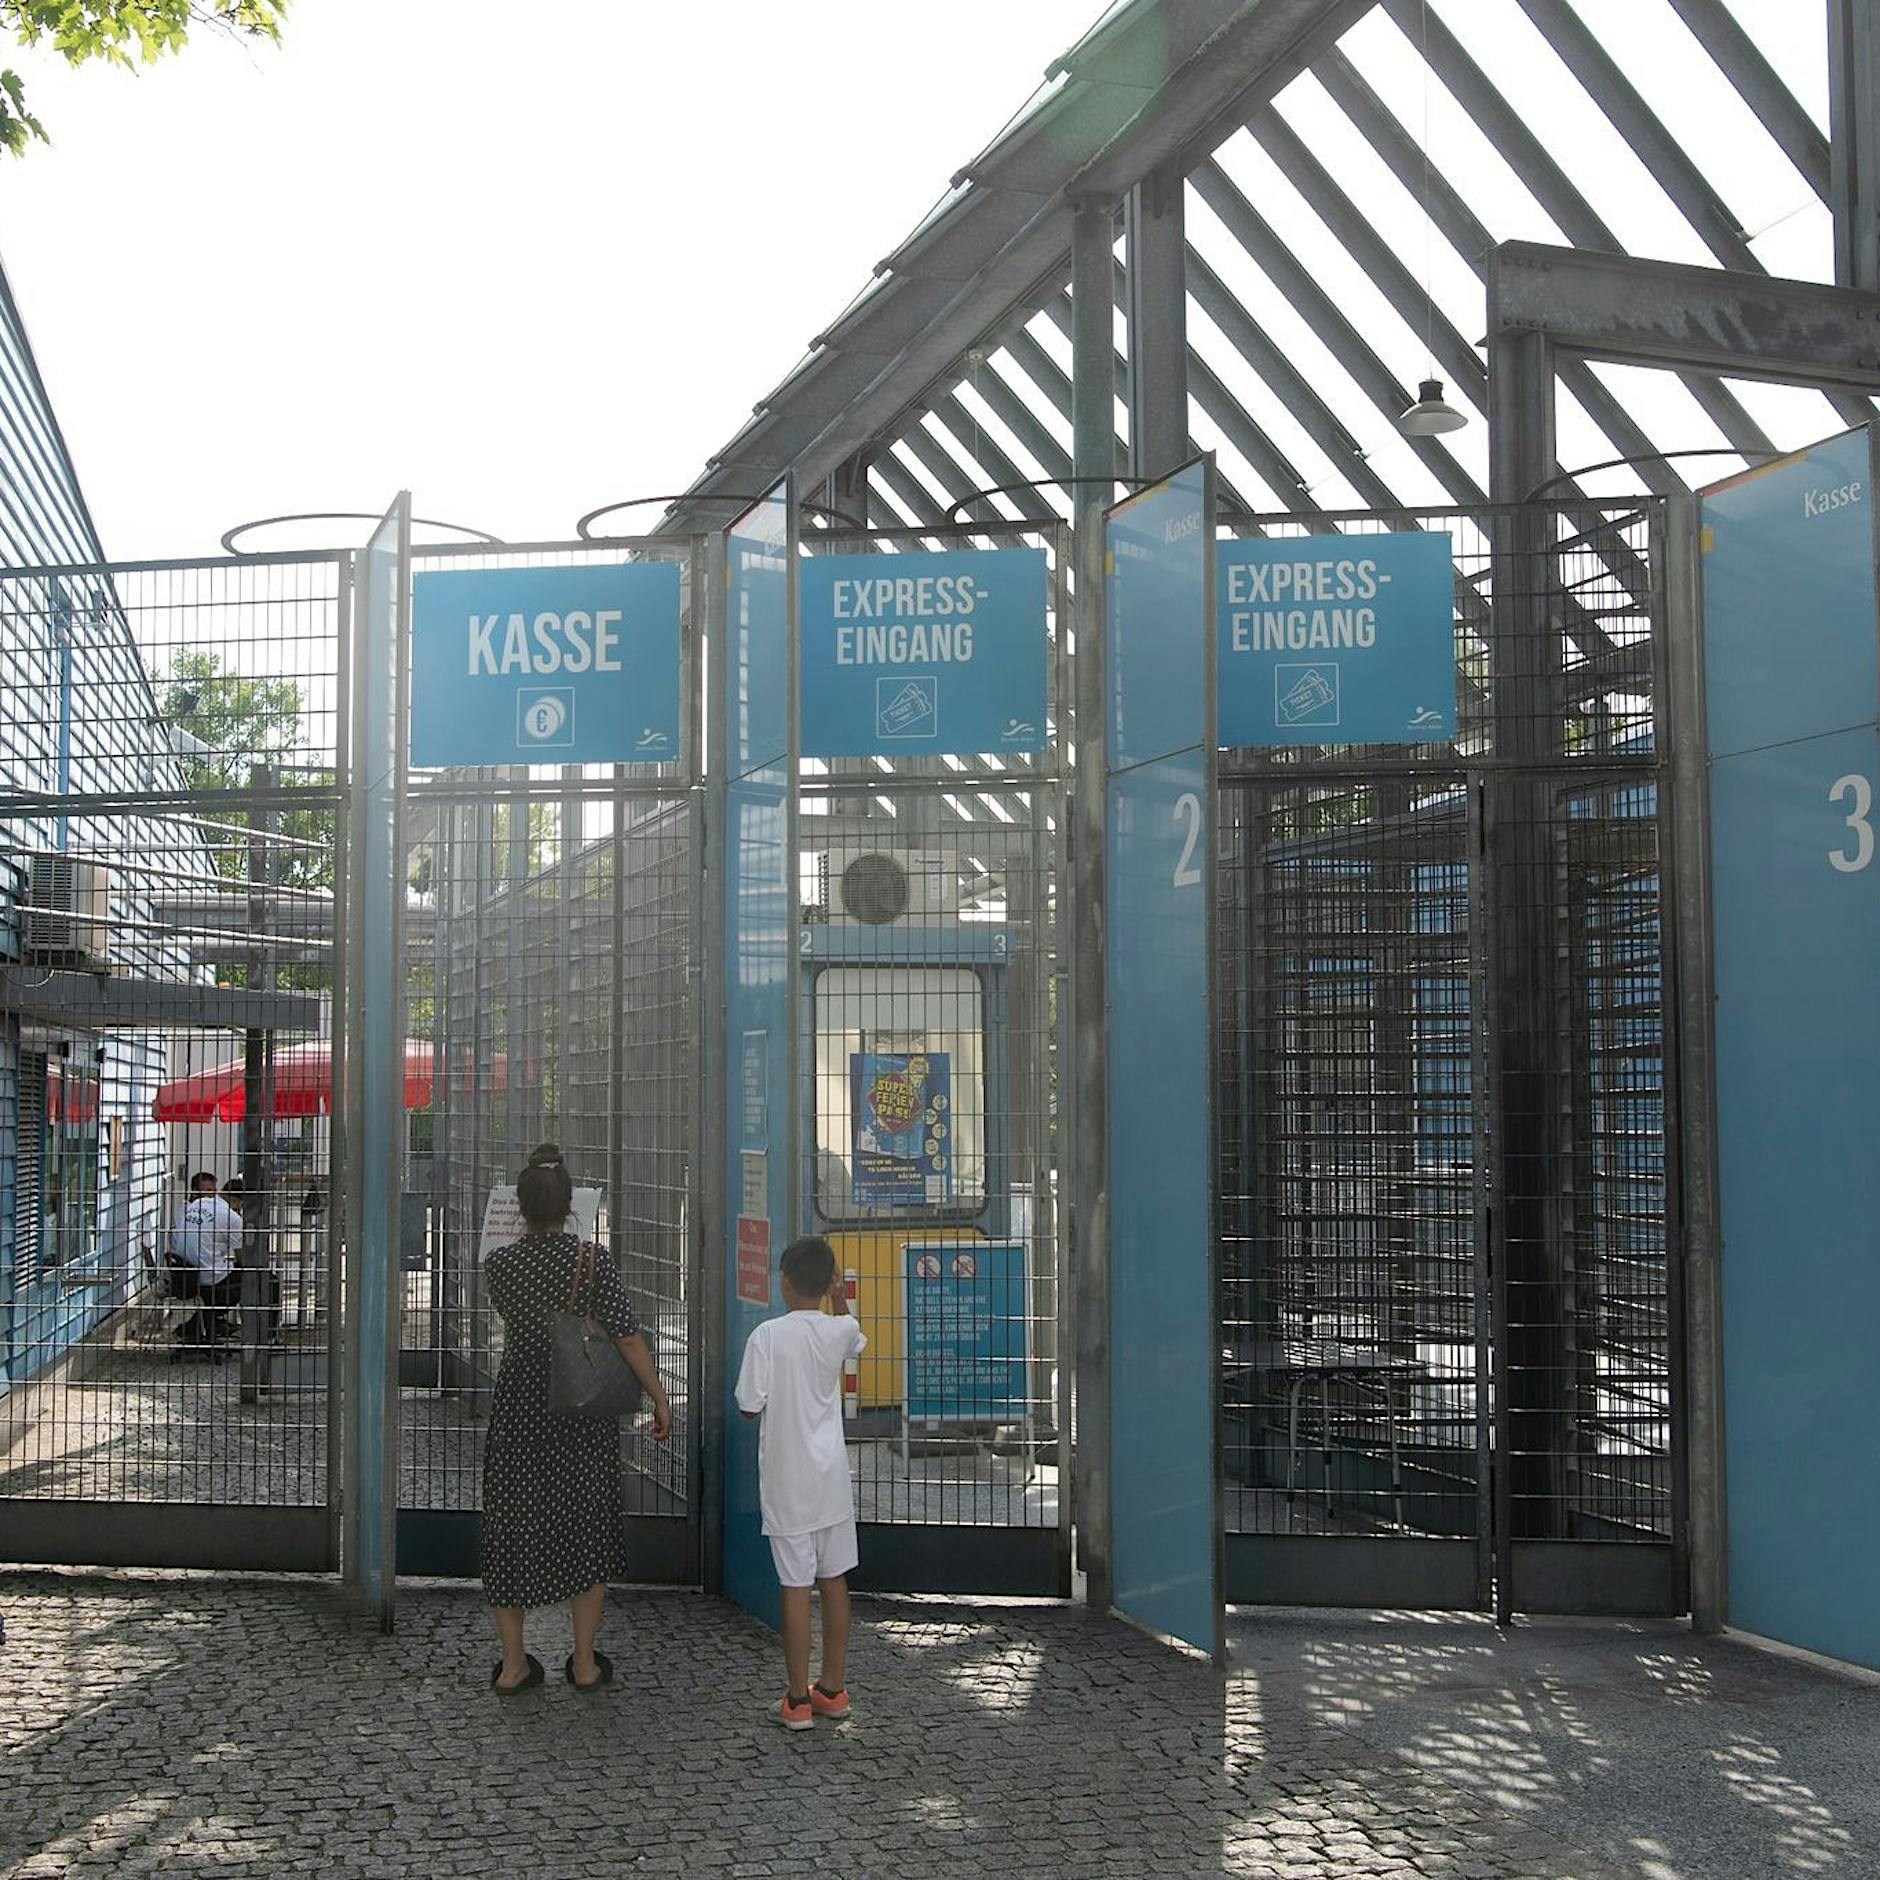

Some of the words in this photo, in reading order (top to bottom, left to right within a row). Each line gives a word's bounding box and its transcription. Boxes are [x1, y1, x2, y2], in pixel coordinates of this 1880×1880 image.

[1804, 482, 1862, 518] Kasse
[1165, 512, 1200, 544] Kasse
[833, 576, 988, 618] EXPRESS-
[1228, 560, 1391, 603] EXPRESS-
[468, 611, 623, 675] KASSE
[837, 622, 974, 665] EINGANG
[1232, 608, 1377, 651] EINGANG
[1173, 792, 1201, 888] 2
[1828, 774, 1875, 873] 3
[799, 931, 813, 953] 2
[994, 935, 1007, 956] 3
